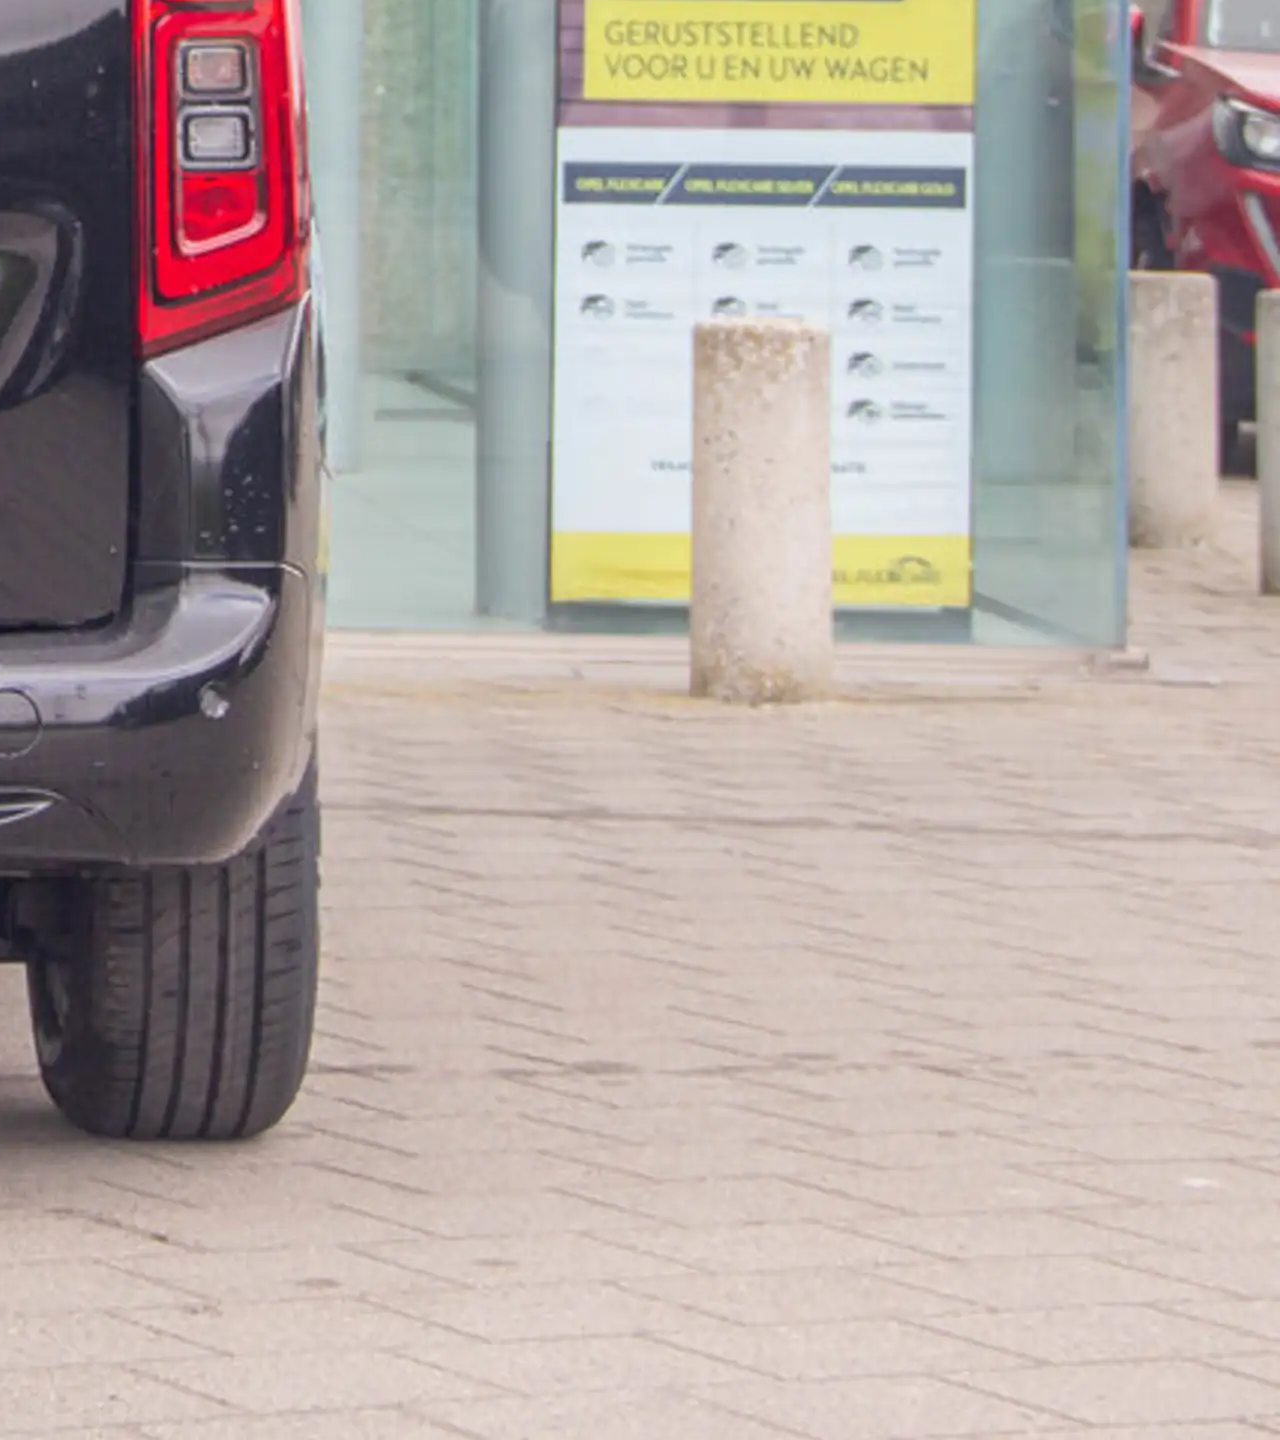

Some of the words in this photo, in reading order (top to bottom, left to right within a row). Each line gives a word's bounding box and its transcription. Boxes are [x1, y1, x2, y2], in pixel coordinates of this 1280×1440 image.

[604, 19, 860, 49] GERUSTSTELLEND
[604, 53, 689, 80] VOOR
[695, 55, 716, 80] U
[724, 55, 761, 81] EN
[769, 55, 815, 83] UW
[823, 56, 929, 83] WAGEN
